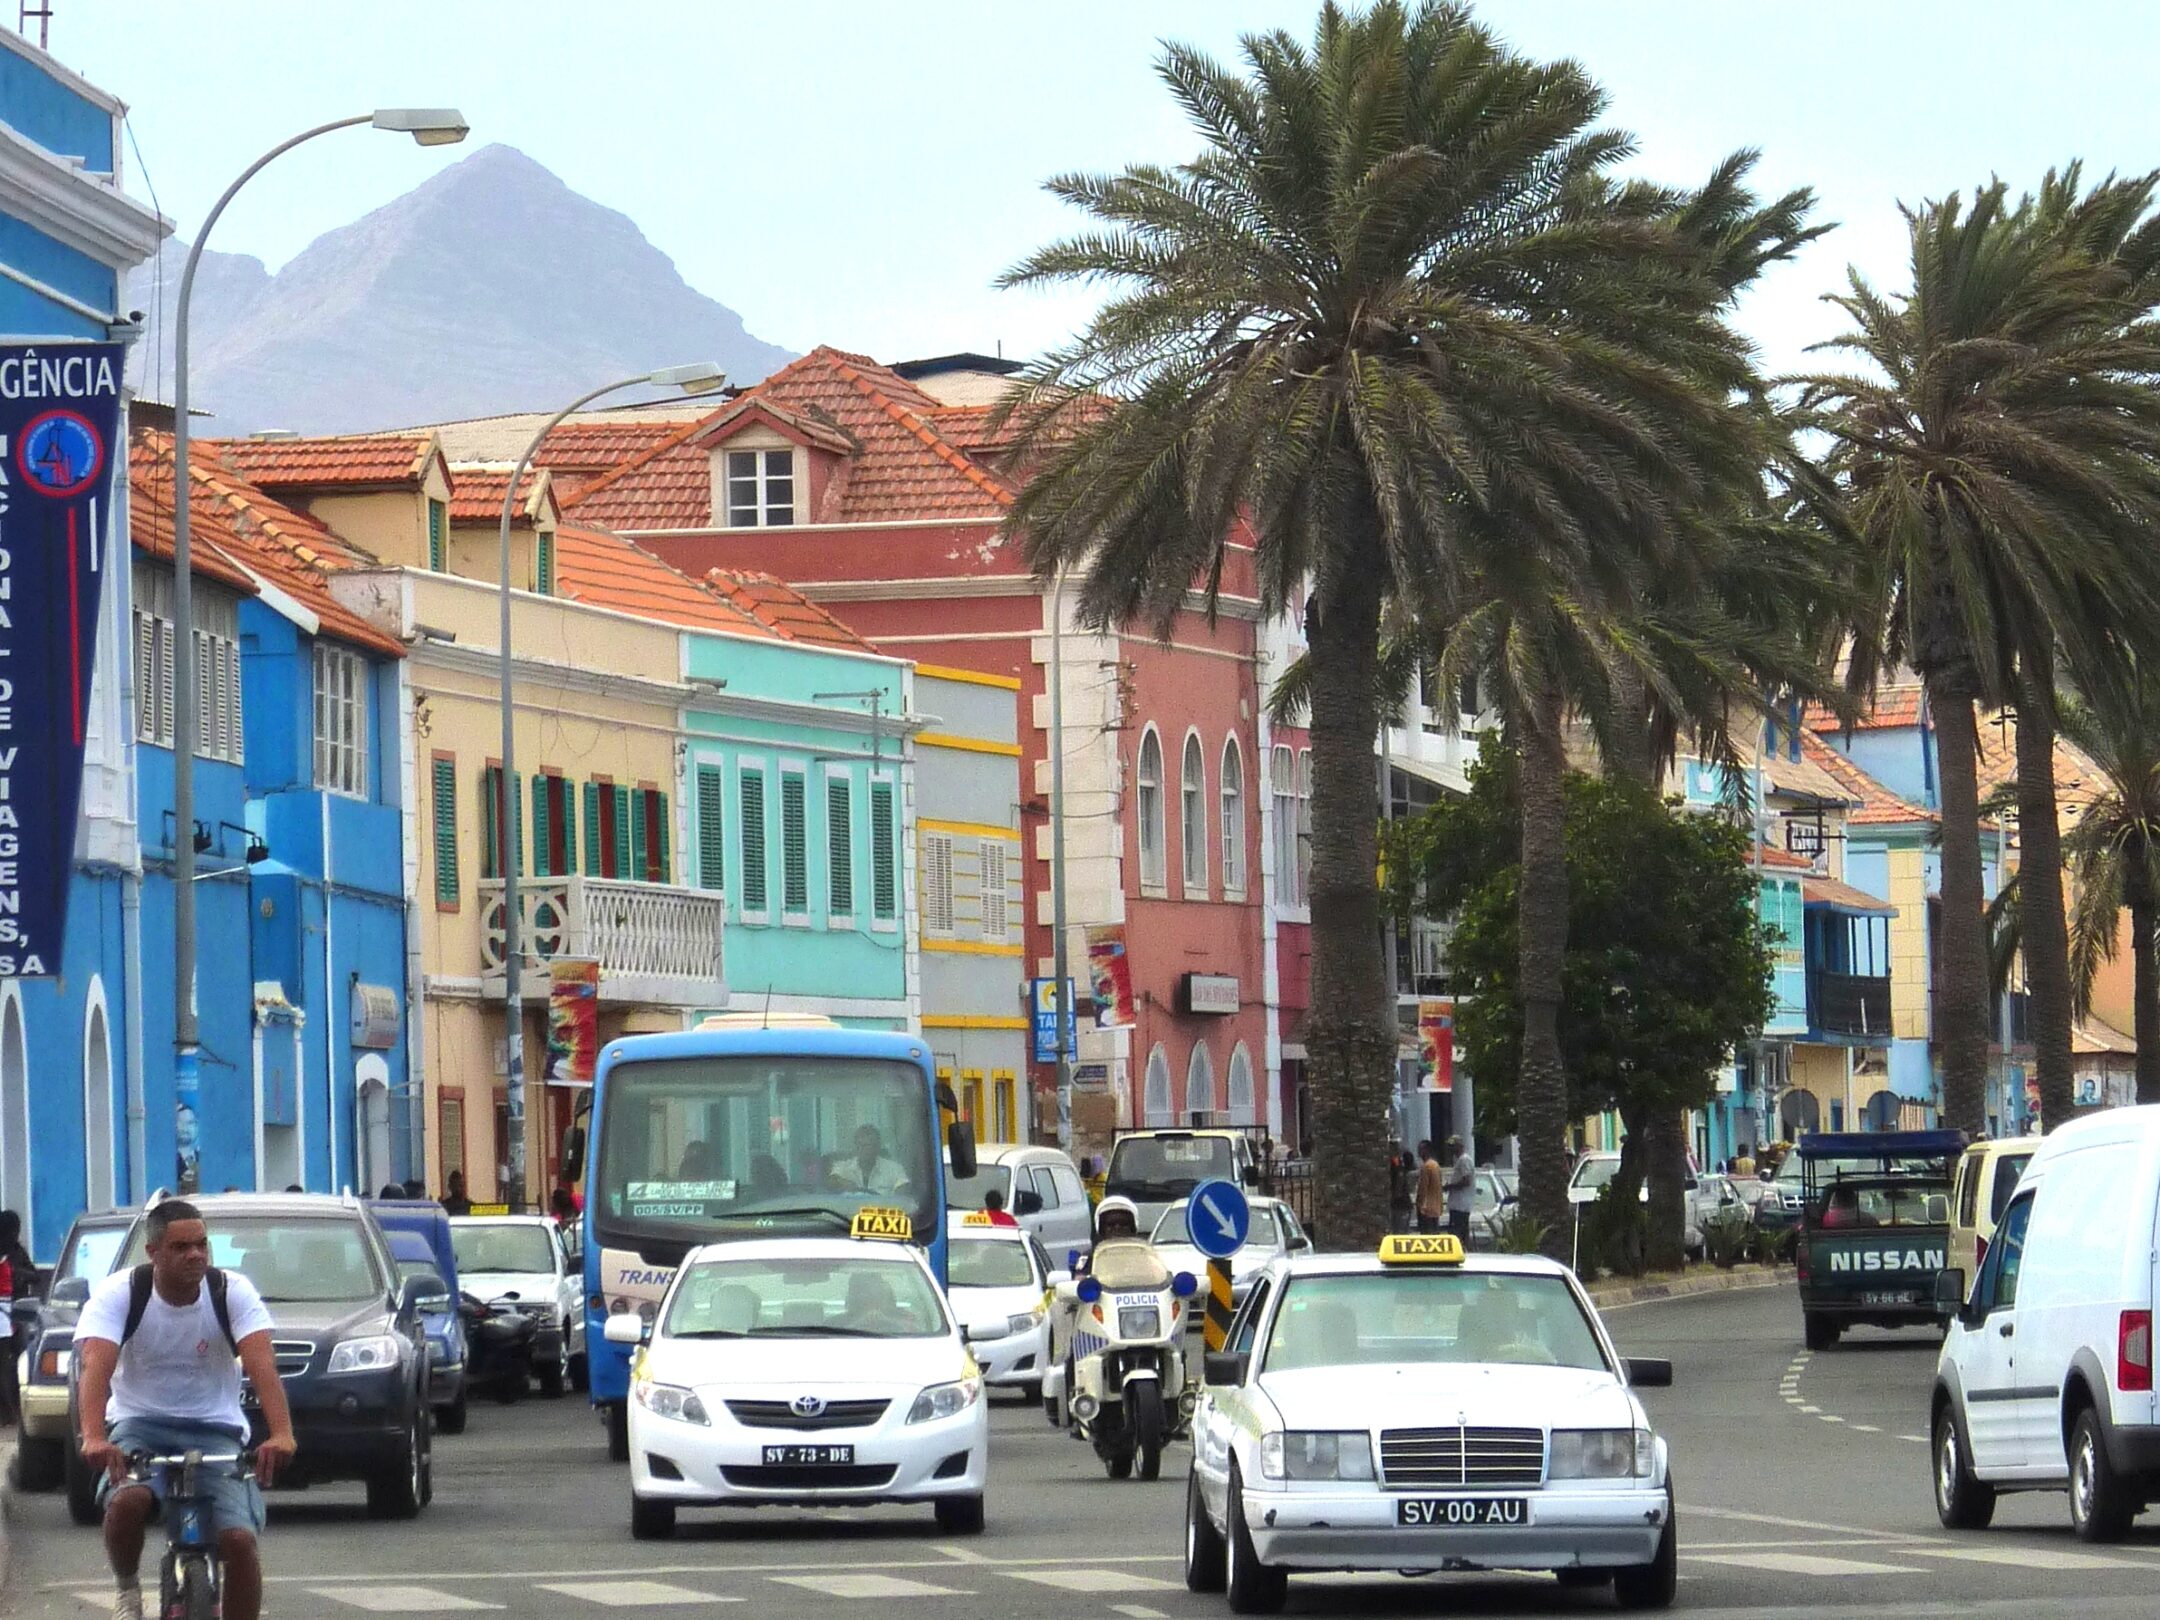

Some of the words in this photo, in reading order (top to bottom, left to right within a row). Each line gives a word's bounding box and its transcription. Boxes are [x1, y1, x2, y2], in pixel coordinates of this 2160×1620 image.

[0, 348, 116, 398] GÊNCIA
[860, 1216, 906, 1233] TAXI
[1395, 1239, 1449, 1253] TAXI
[1831, 1250, 1944, 1271] NISSAN
[1116, 1295, 1159, 1306] POLICIA
